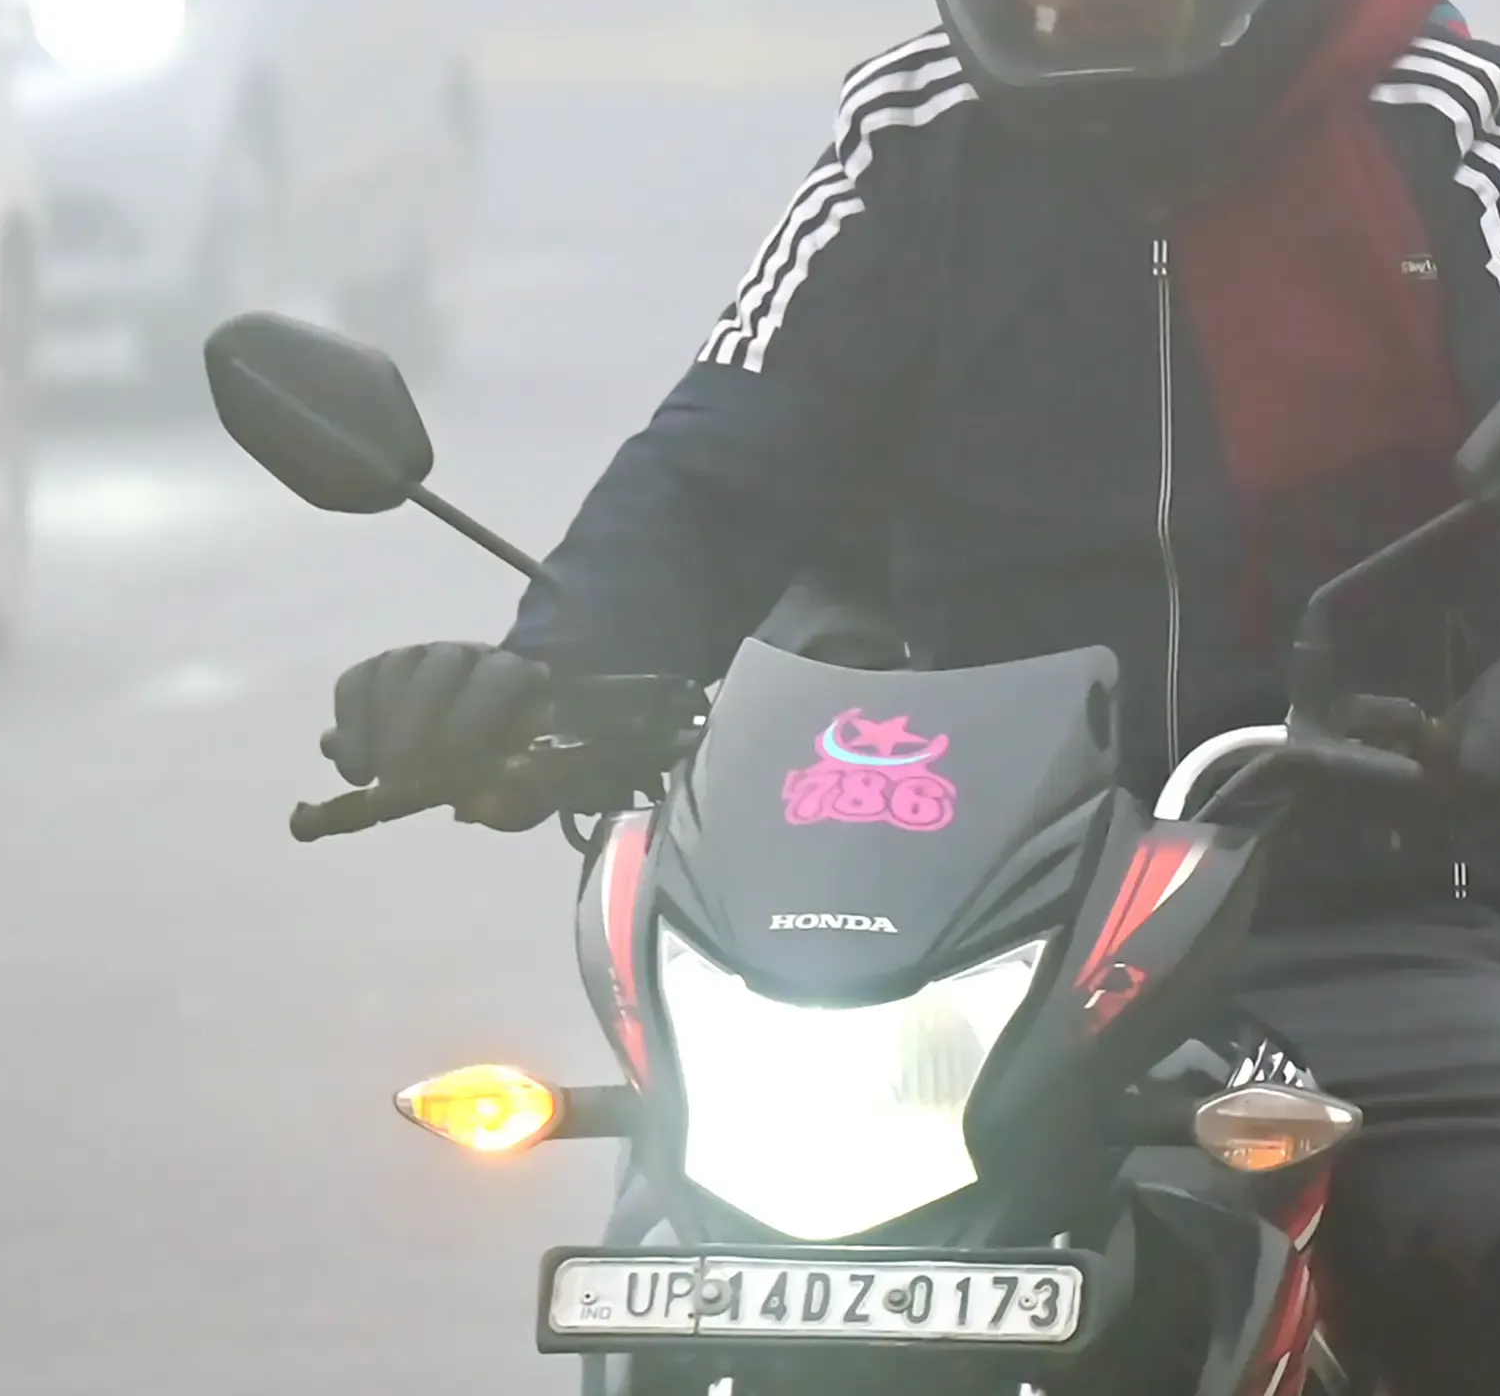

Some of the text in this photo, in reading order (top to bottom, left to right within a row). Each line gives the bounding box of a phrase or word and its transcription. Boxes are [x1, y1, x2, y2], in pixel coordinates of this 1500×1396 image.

[781, 766, 958, 832] 786
[768, 912, 899, 934] HONDA
[579, 1305, 613, 1321] IND
